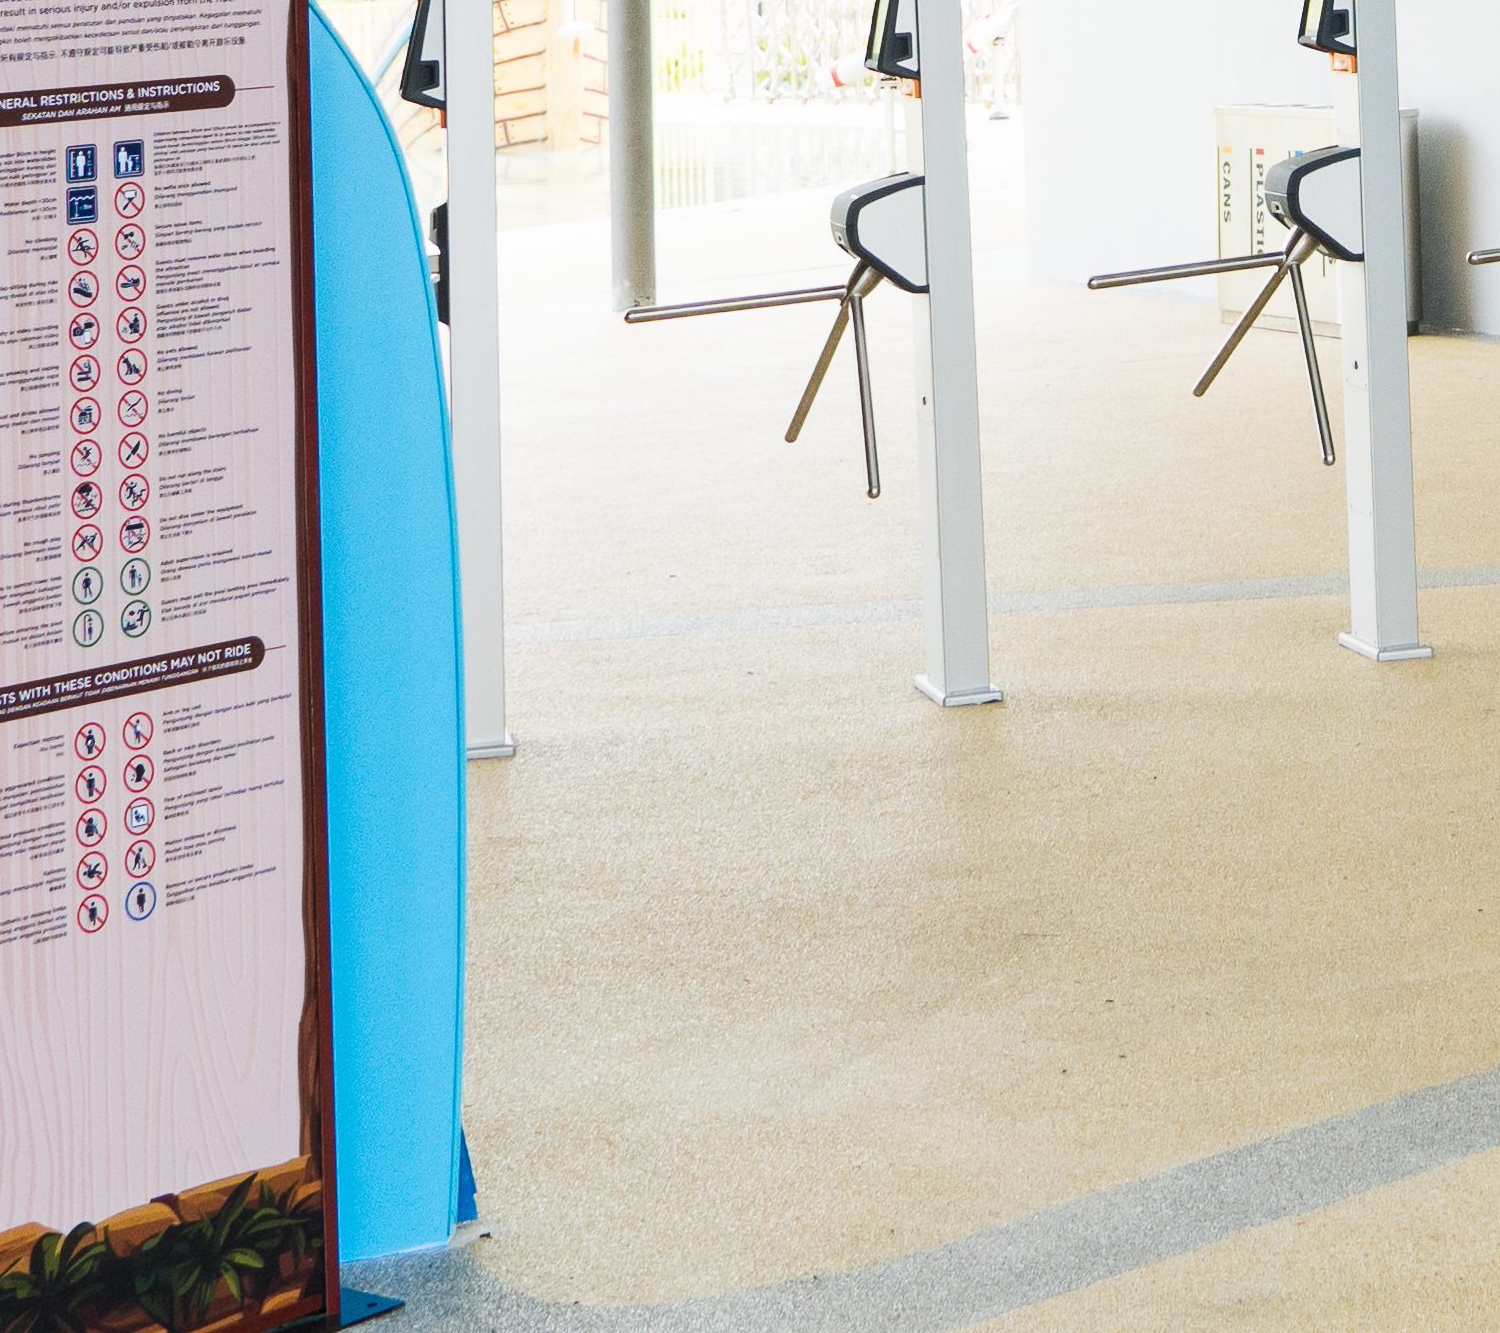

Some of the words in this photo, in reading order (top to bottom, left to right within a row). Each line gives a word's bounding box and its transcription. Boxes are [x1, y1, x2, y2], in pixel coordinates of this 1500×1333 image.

[0, 7, 25, 17] result
[27, 6, 36, 15] in
[38, 4, 71, 14] serious
[73, 2, 98, 14] injury
[100, 0, 130, 10] and/or
[39, 88, 123, 107] RESTRICTIONS
[126, 87, 134, 99] &
[137, 80, 220, 99] INSTRUCTIONS
[1222, 161, 1232, 223] CANS
[18, 684, 50, 702] WITH
[53, 675, 91, 694] THESE
[94, 659, 167, 686] CONDITIONS
[170, 654, 194, 670] MAY
[197, 648, 221, 664] NOT
[224, 642, 251, 658] RIDE
